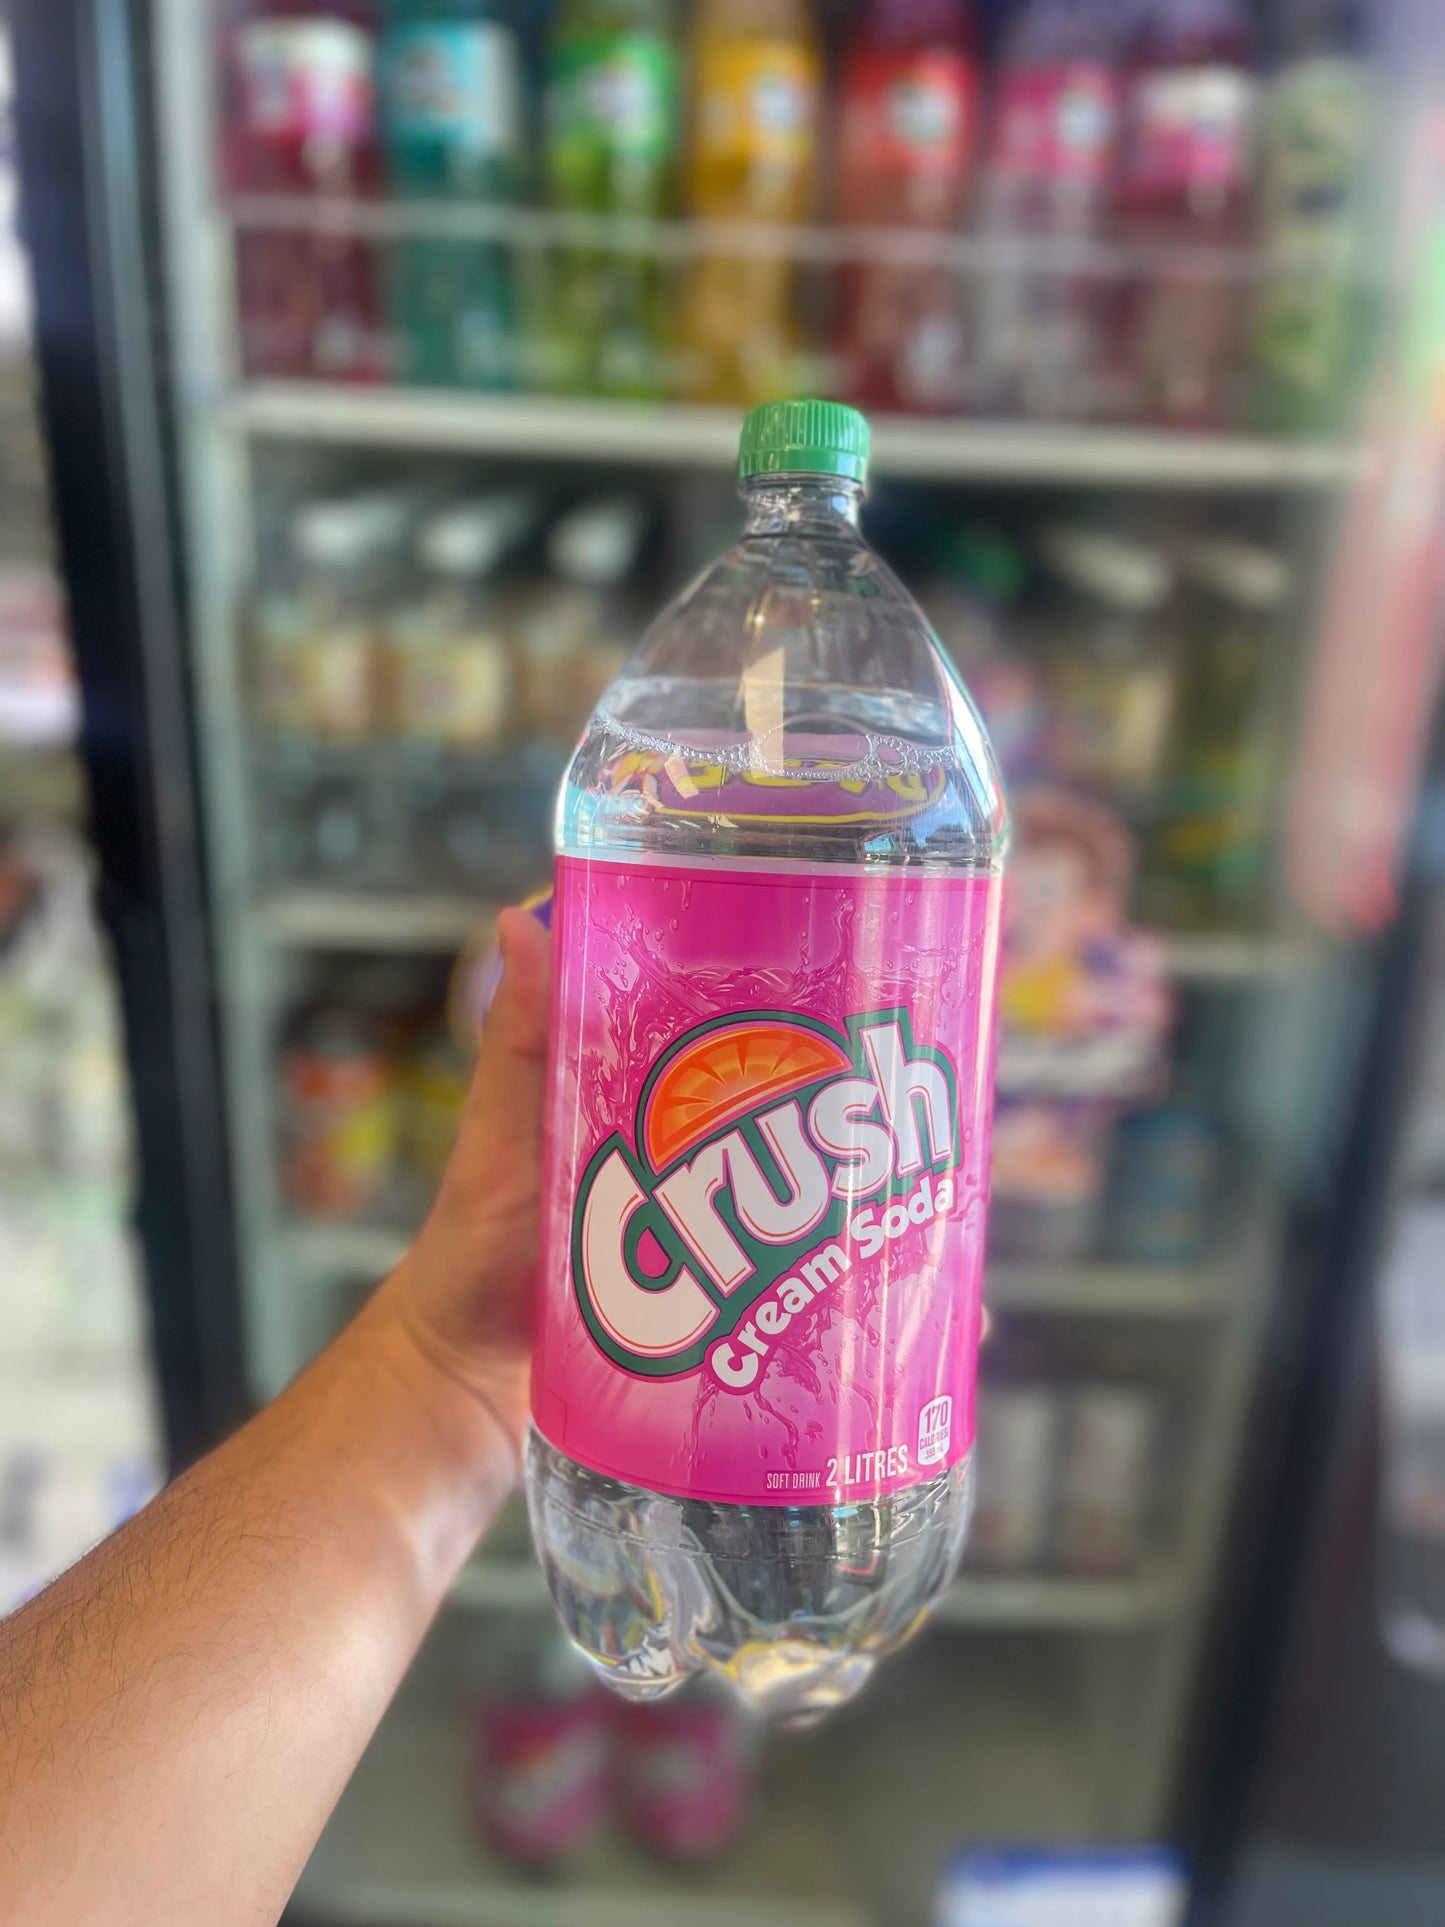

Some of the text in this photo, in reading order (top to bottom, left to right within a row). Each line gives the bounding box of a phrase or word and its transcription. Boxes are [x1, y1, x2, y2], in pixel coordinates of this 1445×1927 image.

[582, 1023, 952, 1356] Crush
[711, 1178, 954, 1388] Cream Soda
[766, 1444, 909, 1489] SOFT DRINK 2 LITRES
[924, 1400, 949, 1434] 170
